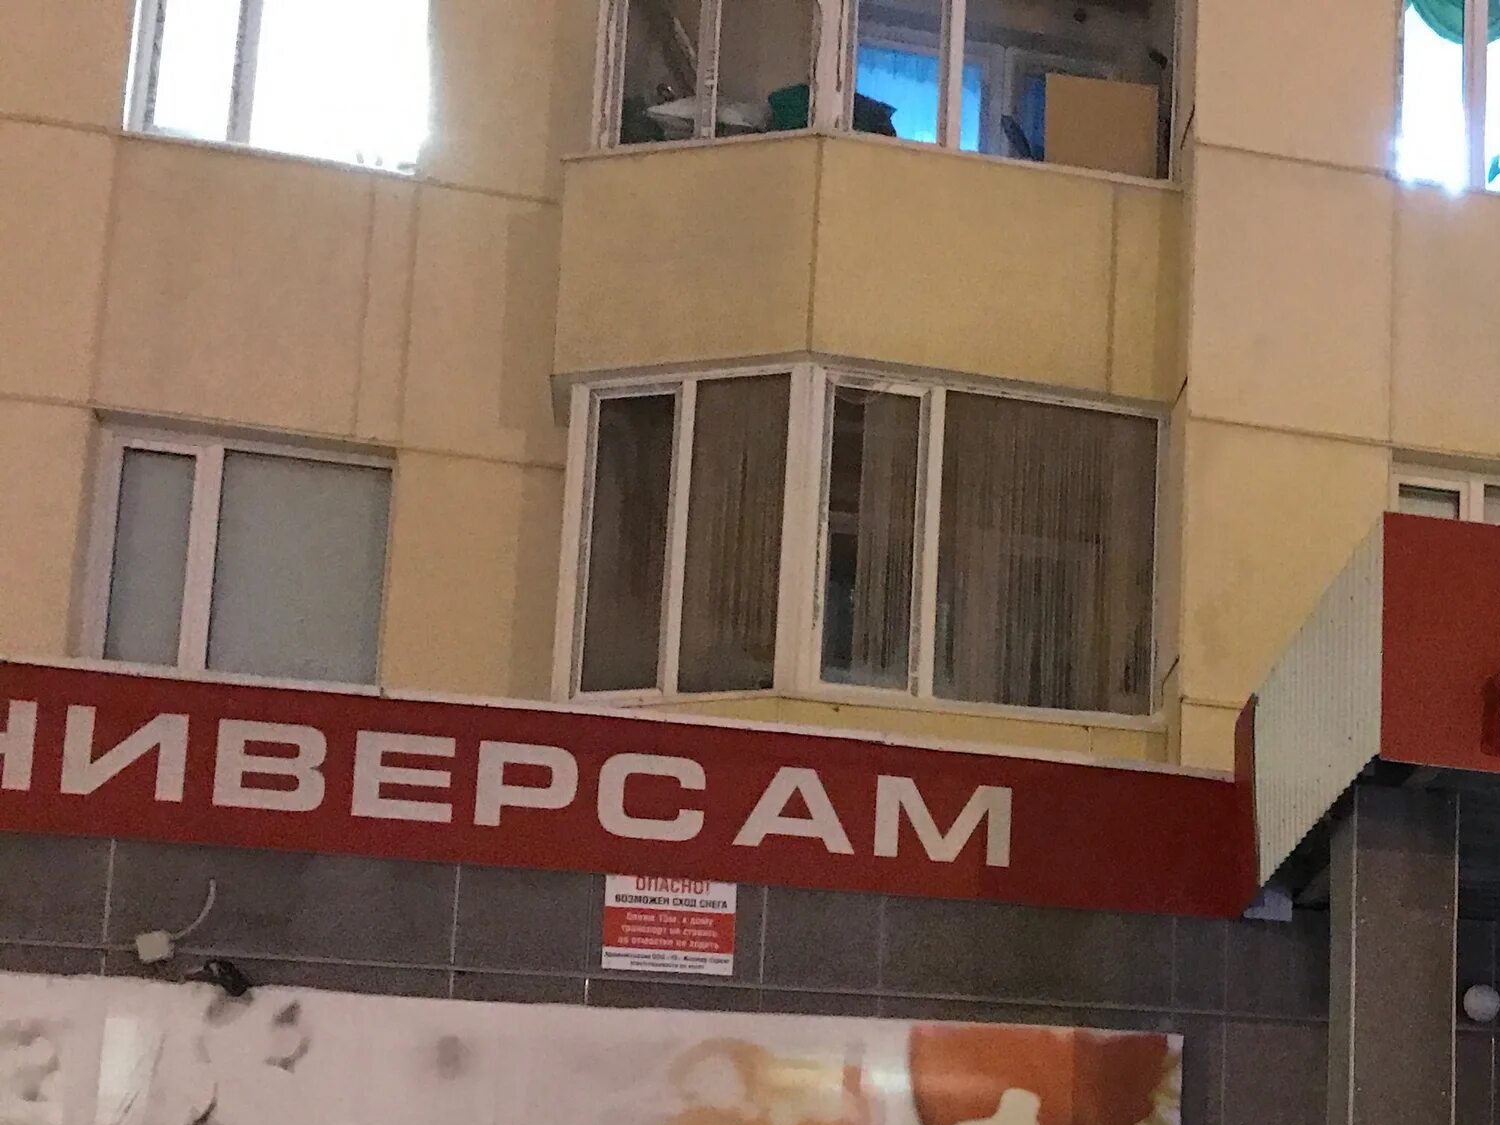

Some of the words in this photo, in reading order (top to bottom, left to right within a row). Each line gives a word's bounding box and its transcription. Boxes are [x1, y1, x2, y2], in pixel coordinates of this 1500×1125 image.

[615, 894, 670, 905] ВОЗМОЖЕН
[672, 897, 697, 908] СХОД
[699, 899, 728, 910] СНЕГА
